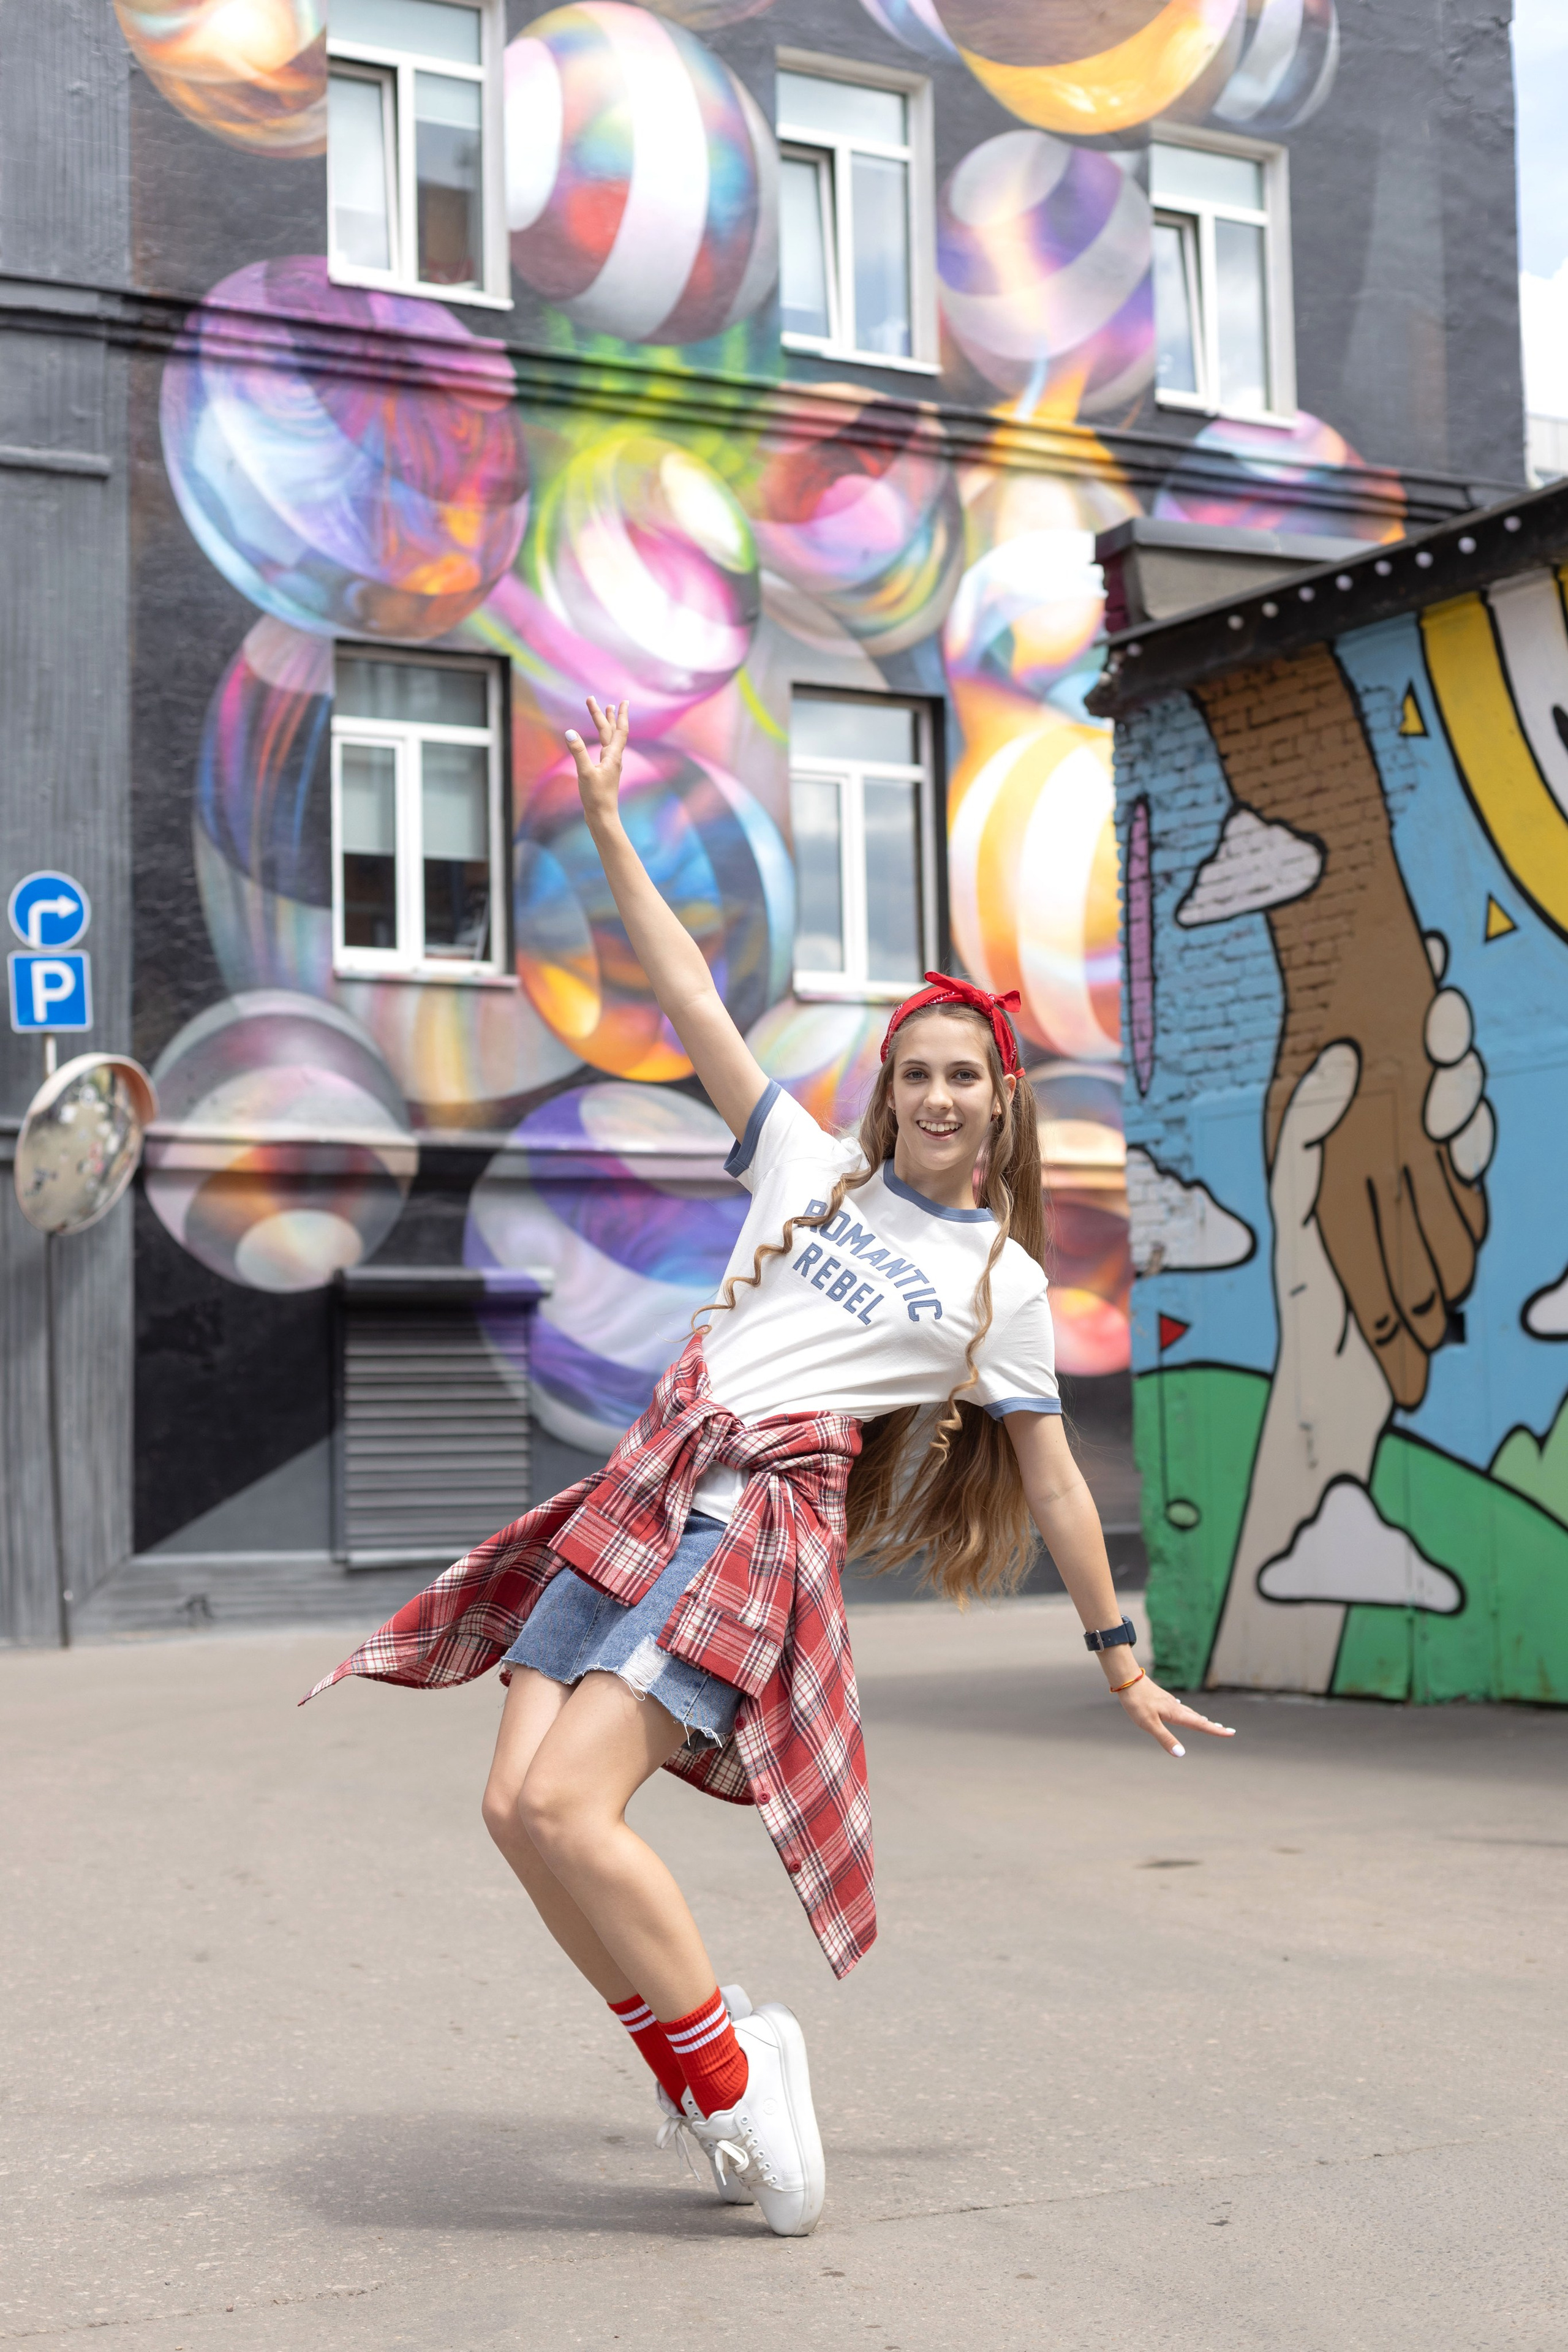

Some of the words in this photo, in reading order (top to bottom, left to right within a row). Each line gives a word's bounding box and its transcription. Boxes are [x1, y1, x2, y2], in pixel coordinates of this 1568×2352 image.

[31, 960, 76, 1022] P
[792, 1242, 884, 1325] REBEL
[797, 1199, 943, 1322] ROMANTIC
